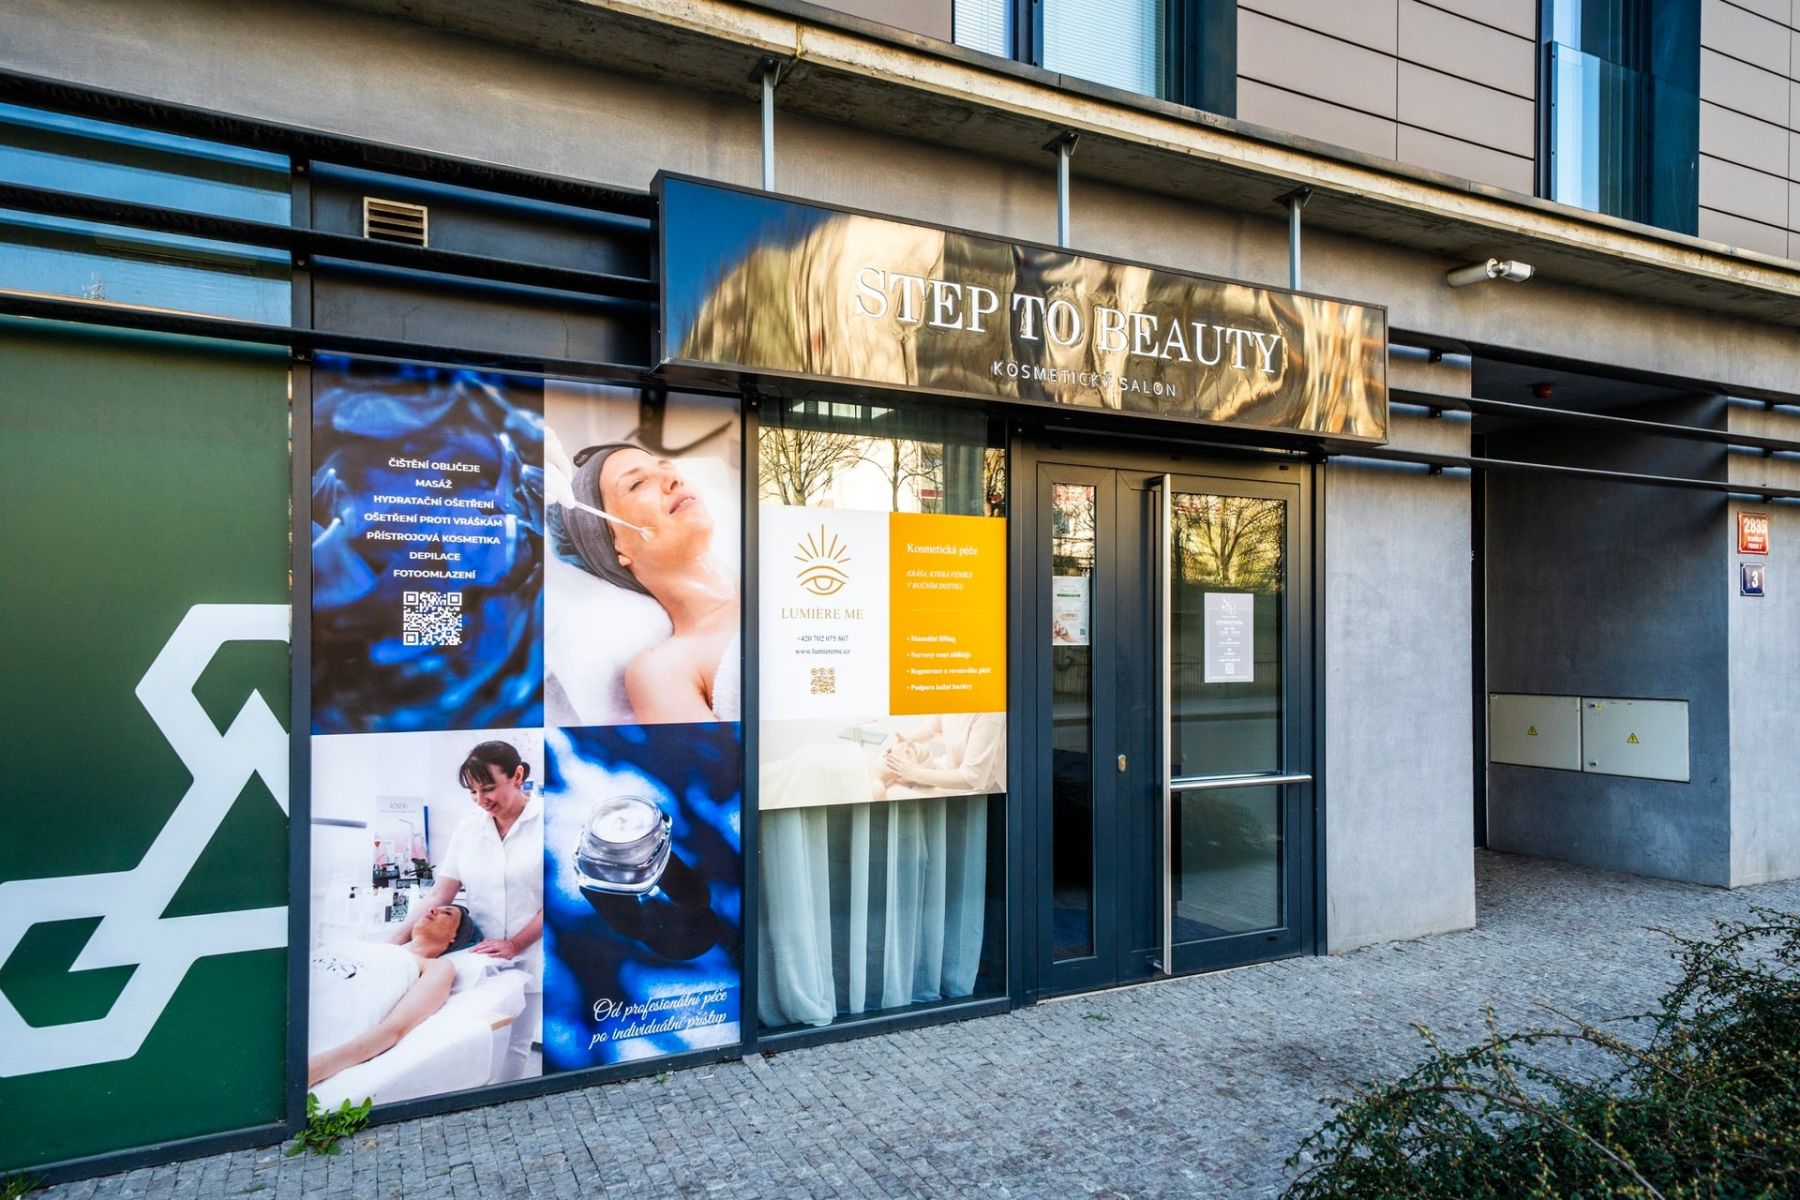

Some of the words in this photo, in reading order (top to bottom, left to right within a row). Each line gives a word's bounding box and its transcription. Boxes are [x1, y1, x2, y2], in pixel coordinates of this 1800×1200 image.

[854, 267, 999, 333] STEP
[1011, 291, 1081, 347] TO
[1095, 306, 1282, 374] BEAUTY
[992, 360, 1113, 390] KOSMETICKÝ
[1119, 376, 1177, 398] SALON
[388, 457, 429, 470] ČIŠTĚNÍ
[432, 460, 481, 473] OBLIČEJE
[415, 478, 453, 489] MASÁŽ
[373, 494, 442, 507] HYDRATAČNÍ
[444, 497, 495, 509] OŠETŘENÍ
[364, 512, 418, 524] OŠETŘENÍ
[419, 515, 451, 525] PROTI
[453, 515, 503, 527] VRÁŠKÁM
[366, 530, 440, 543] PŘÍSTROJOVÁ
[442, 535, 501, 545] KOSMETIKA
[409, 551, 461, 561] DEPILACE
[907, 543, 957, 555] Kosmetická
[959, 546, 978, 557] péče
[393, 569, 476, 579] FOTOOMLAZENÍ
[1751, 570, 1759, 588] 3
[781, 605, 841, 620] LUMIÈRE
[844, 608, 864, 620] ME
[593, 998, 624, 1022] Od
[621, 990, 700, 1022] profesionální
[702, 988, 728, 1009] péče
[588, 1032, 609, 1050] po
